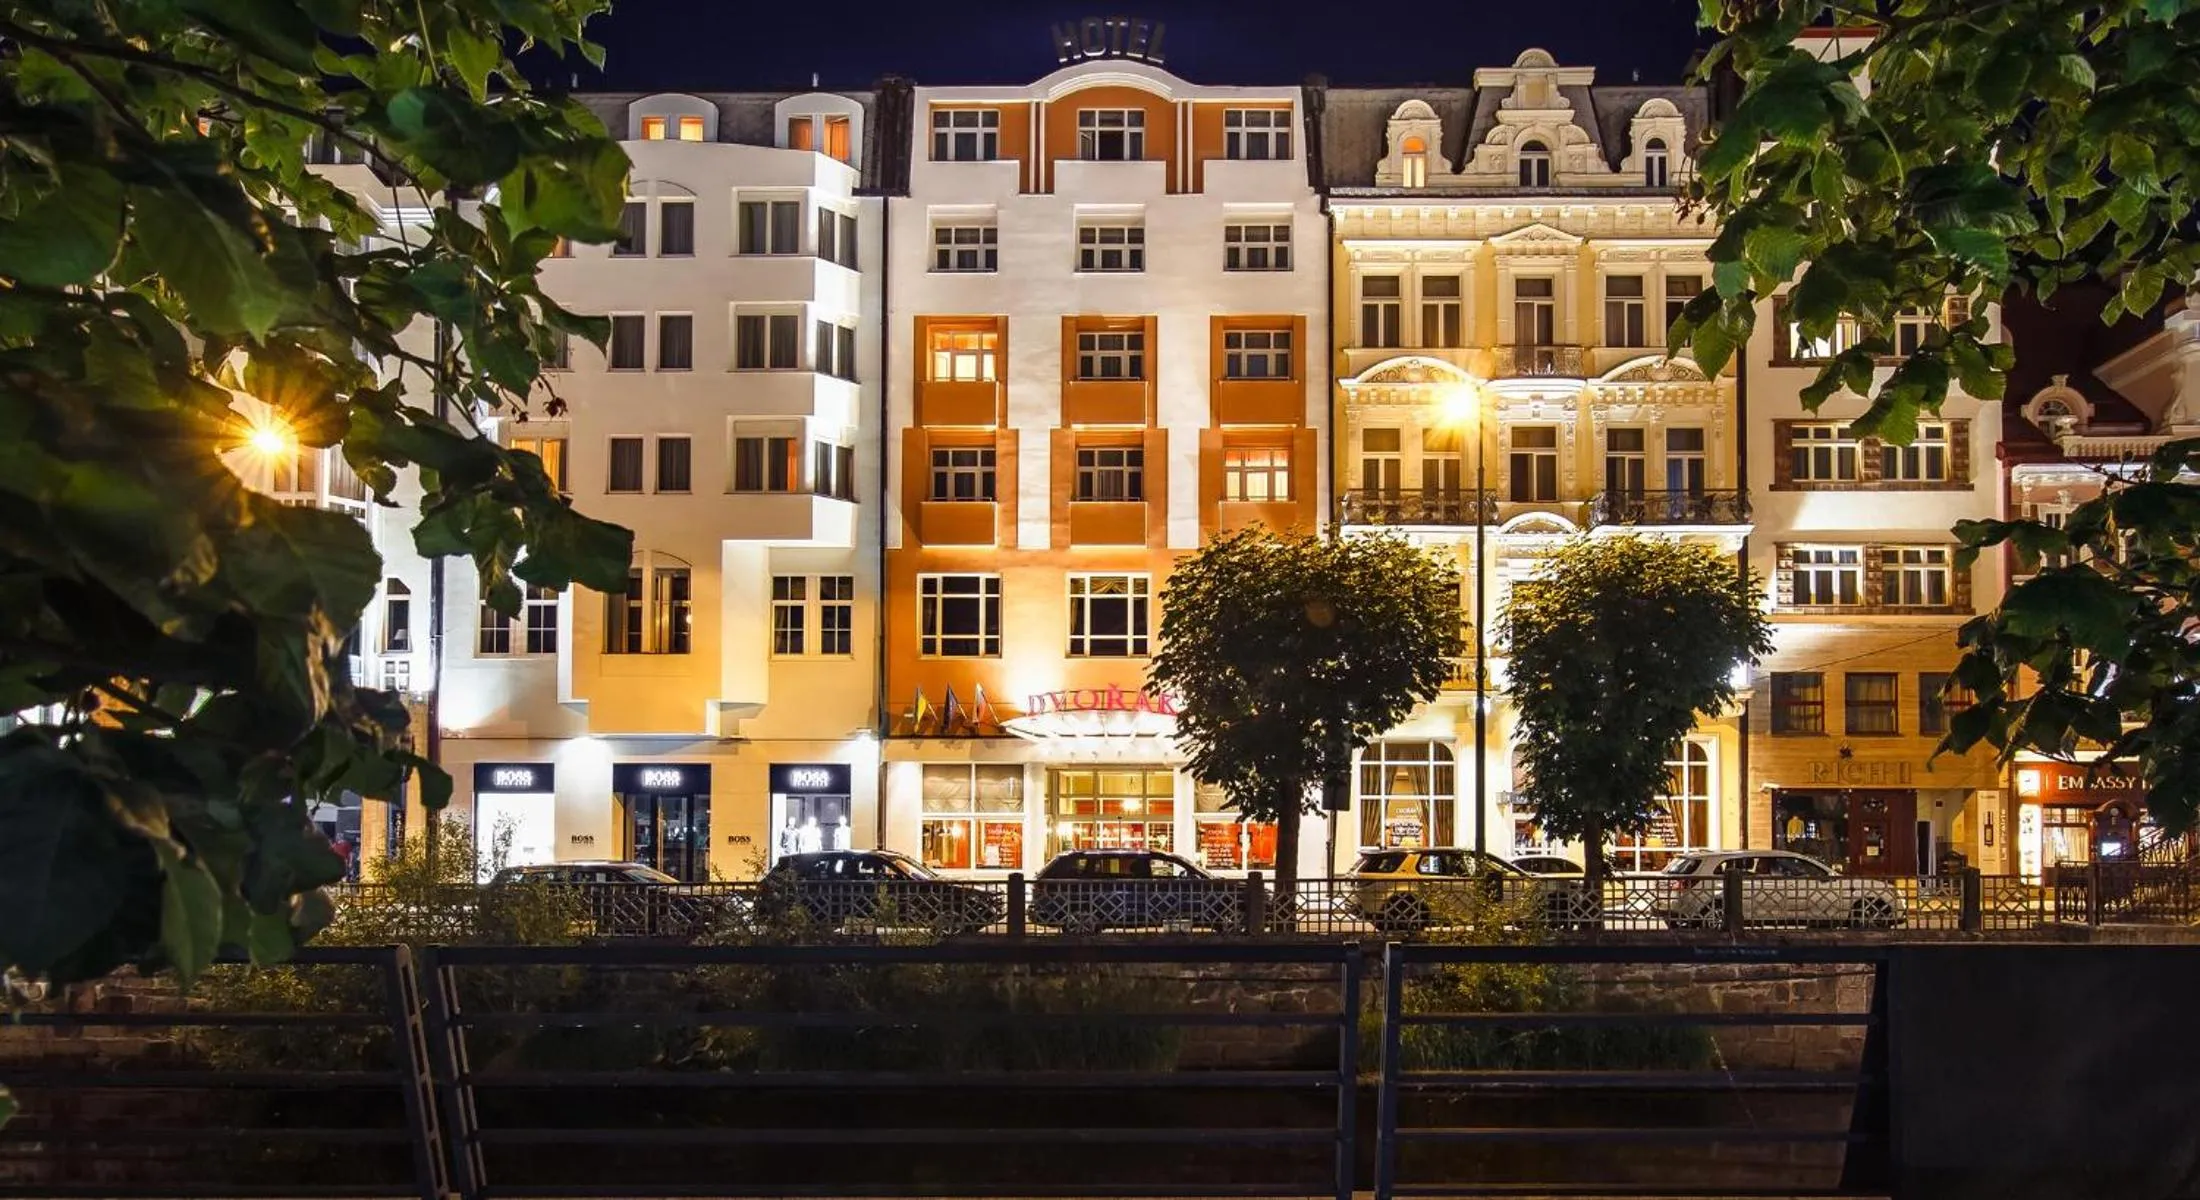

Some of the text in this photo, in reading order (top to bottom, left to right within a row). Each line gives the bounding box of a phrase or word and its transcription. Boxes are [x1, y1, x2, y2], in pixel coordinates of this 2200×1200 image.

[1051, 16, 1166, 63] HOTEL
[495, 770, 531, 783] BOSS
[643, 770, 681, 783] BOSS
[792, 770, 829, 783] BOSS
[2058, 775, 2137, 790] EMASSY
[571, 835, 594, 844] BOSS
[728, 835, 751, 844] BOSS
